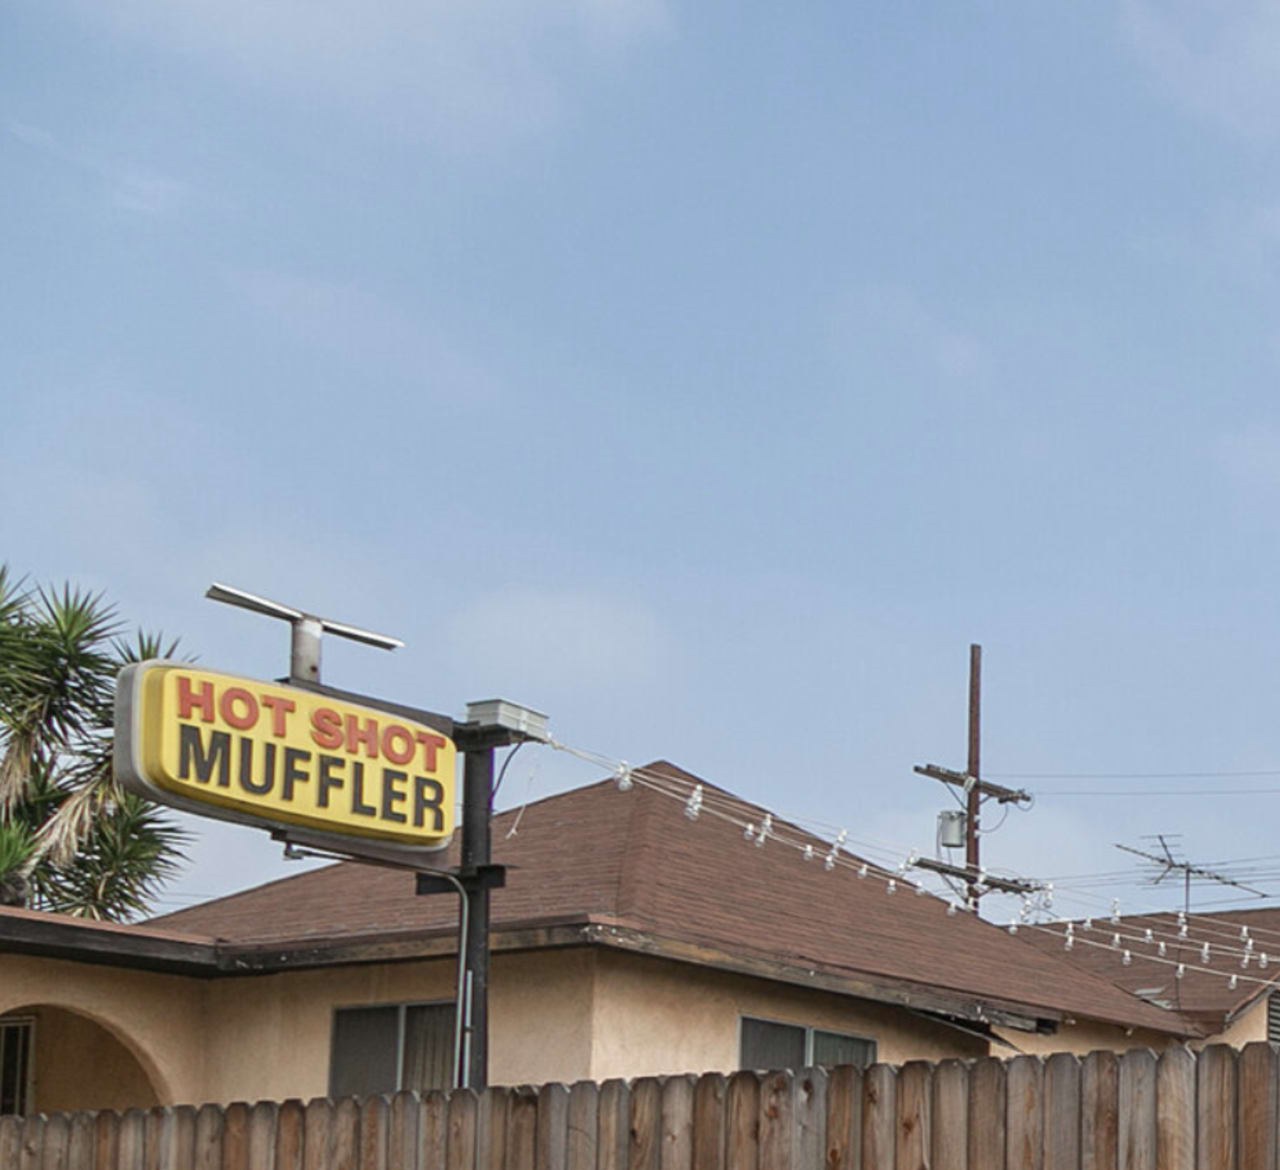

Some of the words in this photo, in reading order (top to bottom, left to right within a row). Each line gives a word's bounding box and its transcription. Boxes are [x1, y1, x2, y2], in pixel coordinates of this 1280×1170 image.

[177, 676, 296, 737] HOT
[309, 707, 447, 773] SHOT
[178, 723, 445, 832] MUFFLER
